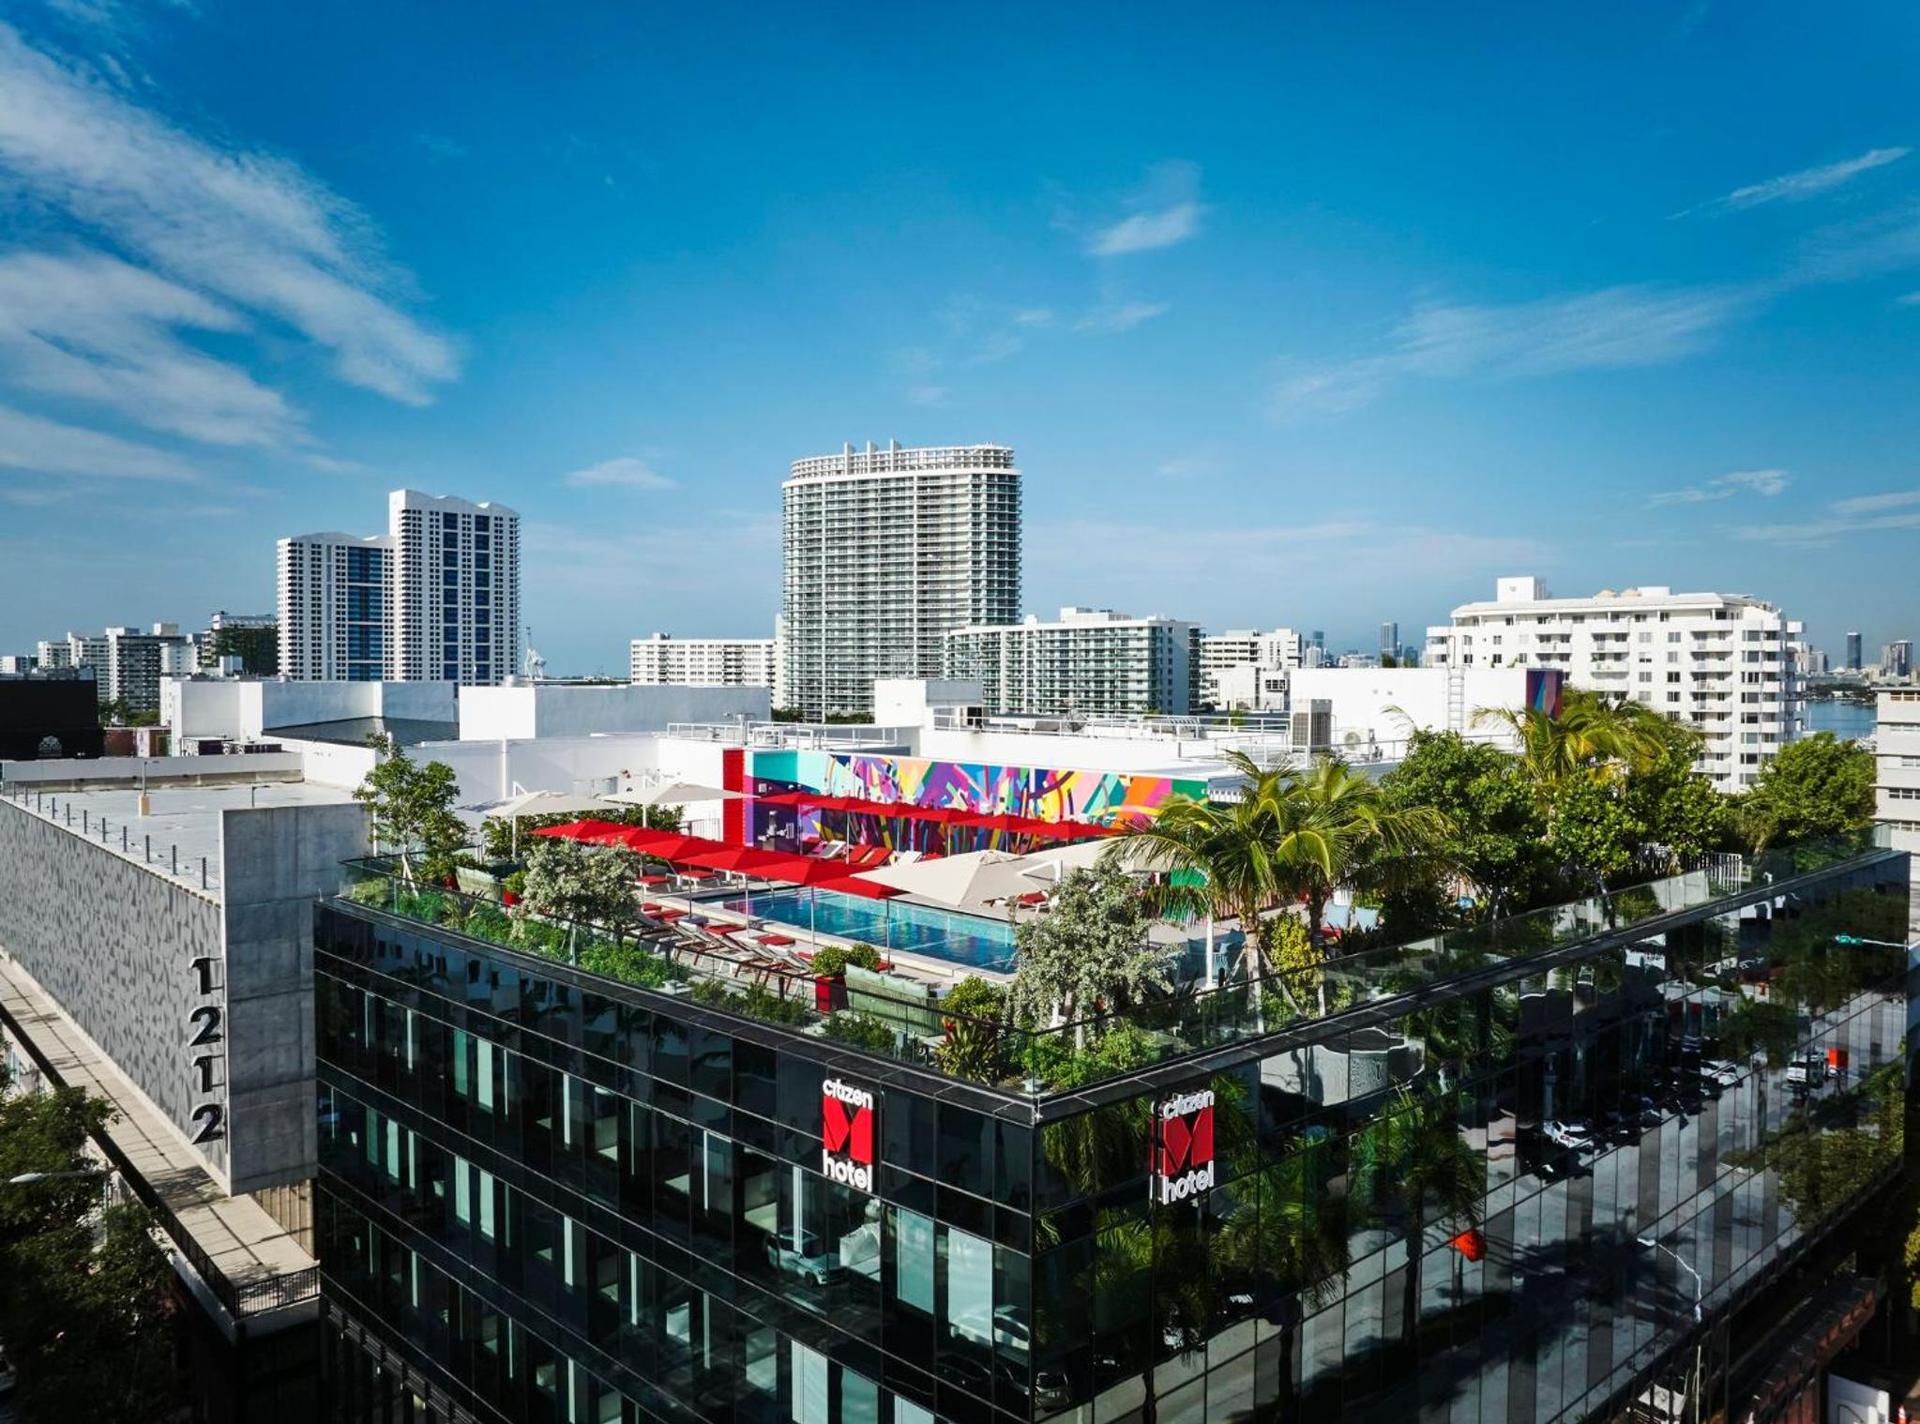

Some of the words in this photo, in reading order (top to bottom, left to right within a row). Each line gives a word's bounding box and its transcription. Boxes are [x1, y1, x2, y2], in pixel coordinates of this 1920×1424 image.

[188, 957, 223, 1144] 1212
[822, 1078, 873, 1109] citizen
[1163, 1090, 1214, 1119] citizen
[822, 1148, 873, 1191] hotel
[1162, 1160, 1214, 1204] hotel
